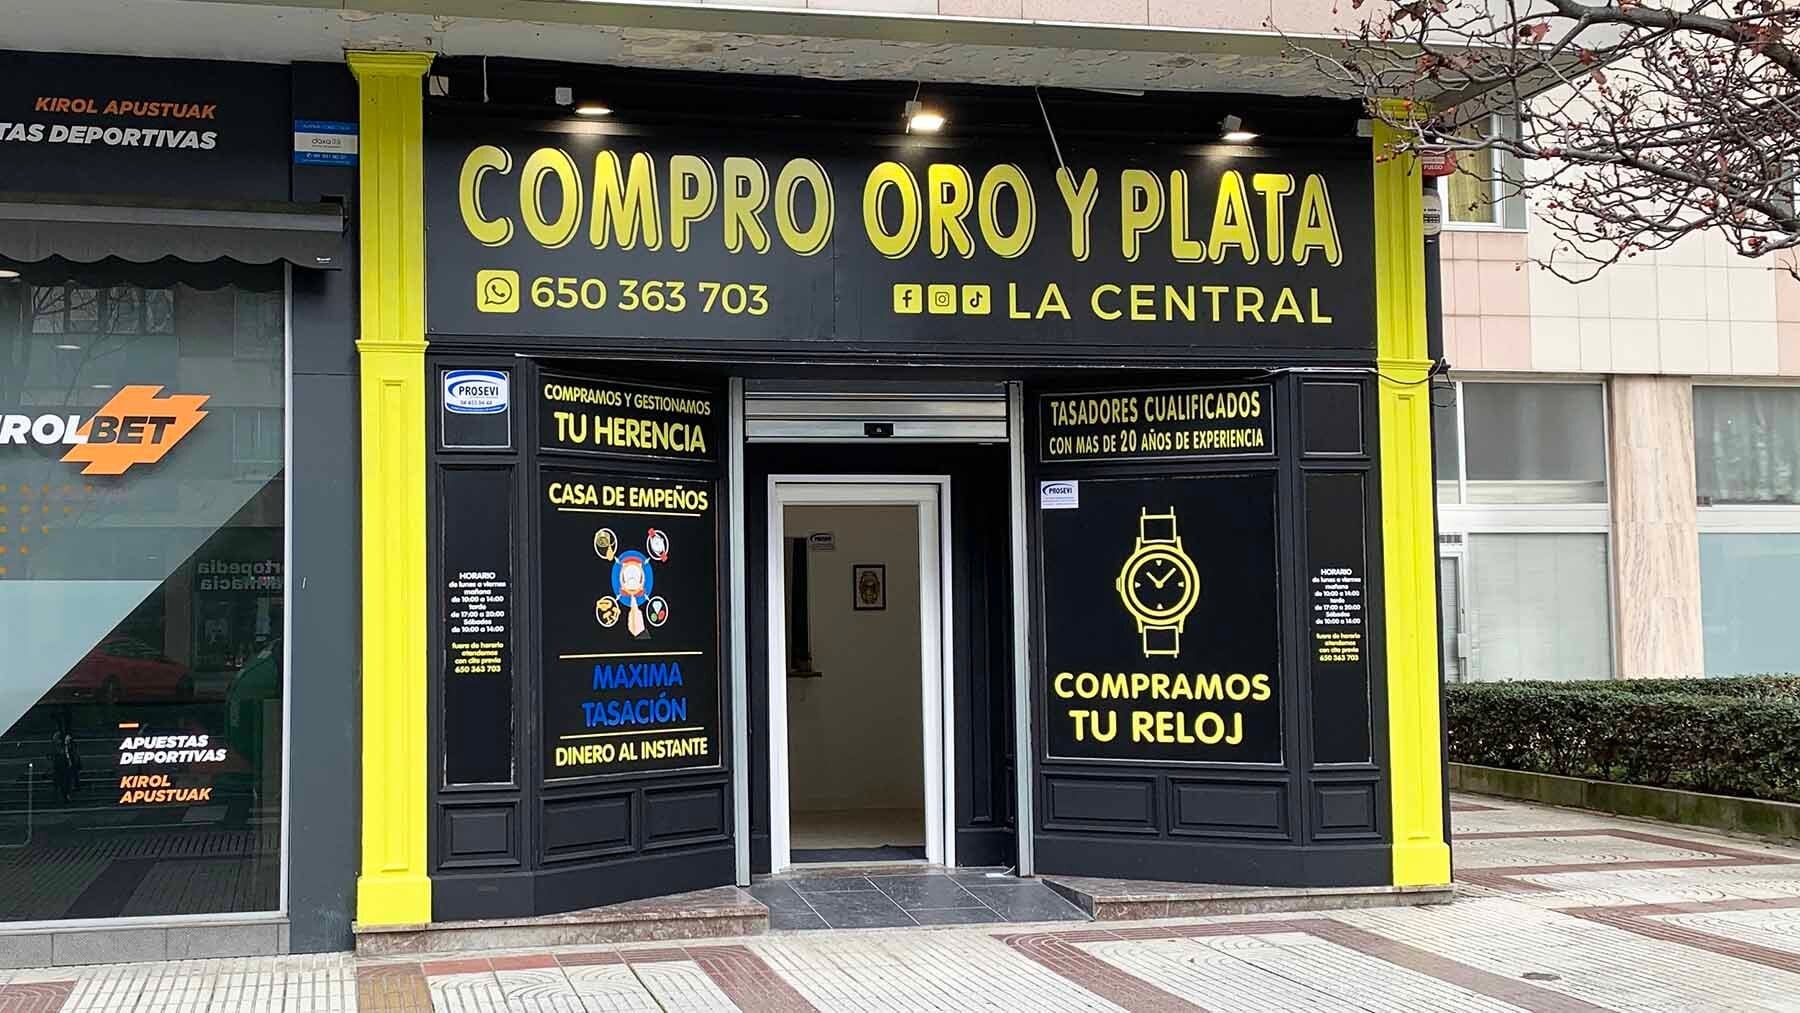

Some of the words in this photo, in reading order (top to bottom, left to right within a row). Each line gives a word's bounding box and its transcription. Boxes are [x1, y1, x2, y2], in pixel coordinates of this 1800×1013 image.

[35, 97, 98, 114] KIROL
[103, 99, 216, 120] APUSTUAK
[49, 125, 218, 150] DEPORTIVAS
[459, 144, 835, 257] COMPRO
[863, 160, 1037, 260] ORO
[1055, 166, 1099, 263] Y
[1121, 168, 1343, 267] PLATA
[530, 276, 607, 310] 650
[617, 279, 688, 313] 363
[698, 281, 769, 316] 703
[1008, 282, 1071, 321] LA
[1090, 283, 1333, 324] CENTRAL
[458, 386, 499, 396] PROSEVI
[544, 383, 622, 406] COMPRAMOS
[624, 392, 632, 407] Y
[634, 394, 711, 416] GESTIONAMOS
[1050, 397, 1138, 426] TASADORES
[1144, 390, 1261, 422] CUALIFICADOS
[0, 413, 176, 445] ROLBET
[553, 411, 587, 443] TU
[594, 415, 706, 453] HERENCIA
[1050, 436, 1073, 455] CON
[1076, 435, 1099, 454] MAS
[1103, 434, 1117, 453] DE
[1120, 430, 1137, 452] 20
[1141, 428, 1172, 452] AÑOS
[1175, 431, 1190, 450] DE
[1193, 428, 1264, 449] EXPERIENCIA
[549, 482, 598, 506] CASA
[602, 485, 625, 506] DE
[629, 484, 709, 511] EMPEÑOS
[592, 662, 683, 690] MAXIMA
[1054, 672, 1271, 701] COMPRAMOS
[581, 691, 687, 727] TASACIÓN
[119, 734, 209, 750] APUESTAS
[1068, 710, 1118, 743] TU
[1132, 710, 1244, 745] RELOJ
[119, 748, 226, 765] DEPORTIVAS
[555, 743, 615, 767] DINERO
[618, 742, 638, 762] AL
[641, 737, 708, 760] INSTANTE
[119, 775, 171, 789] KIROL
[119, 786, 212, 803] APUSTUAK
